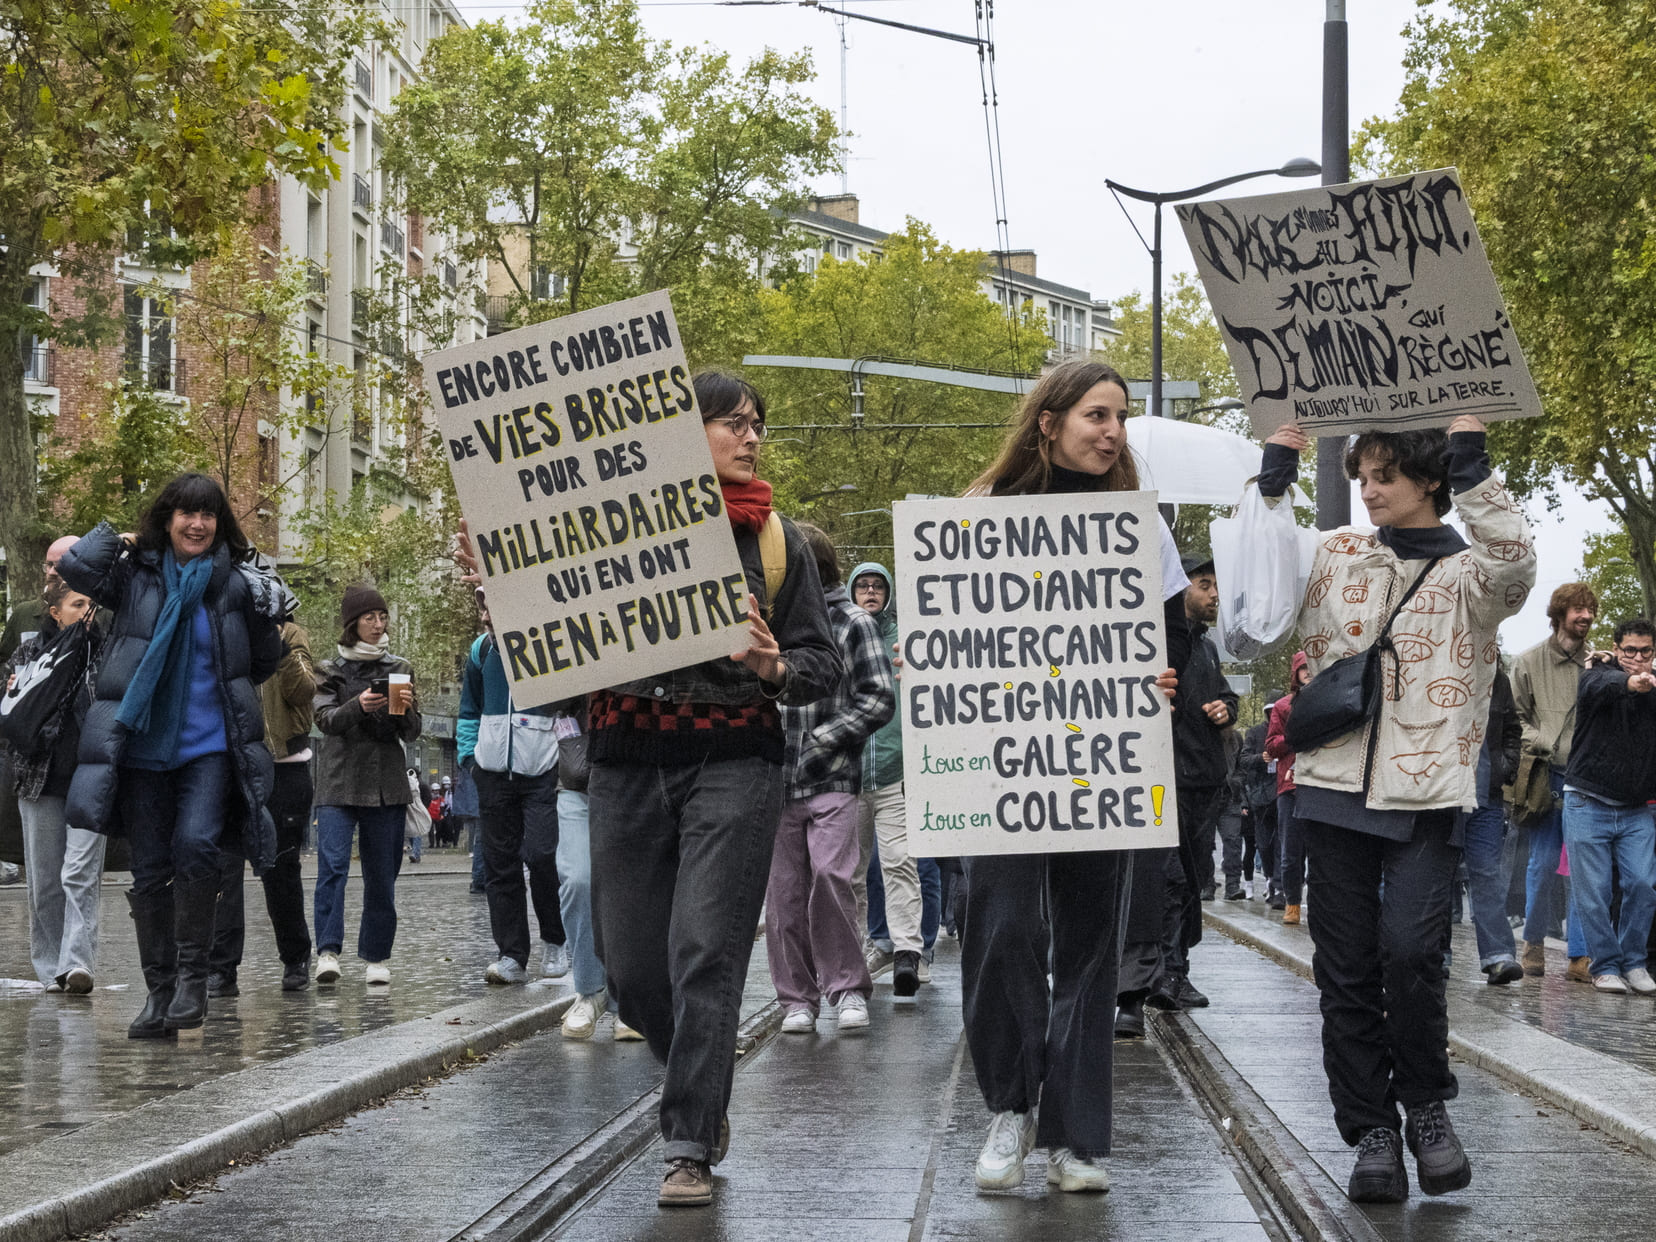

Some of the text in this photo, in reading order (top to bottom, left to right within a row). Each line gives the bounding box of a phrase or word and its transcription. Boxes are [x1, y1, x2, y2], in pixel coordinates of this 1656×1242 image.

[1315, 239, 1345, 265] AU
[437, 345, 548, 408] ENCORE
[1222, 313, 1398, 404] DEMAIN
[1388, 388, 1424, 412] SUR
[1427, 386, 1449, 404] LA
[1448, 380, 1515, 400] TERRE.
[449, 434, 479, 462] DE
[518, 440, 648, 502] POUR DES
[594, 553, 635, 591] EN
[638, 538, 691, 580] ONT
[598, 610, 619, 646] À
[617, 572, 751, 653] FOUTRE
[904, 621, 1158, 678] COMMERÇANTS
[920, 722, 1143, 779] tous en GALÈRE
[919, 801, 965, 832] tous
[969, 811, 992, 828] en
